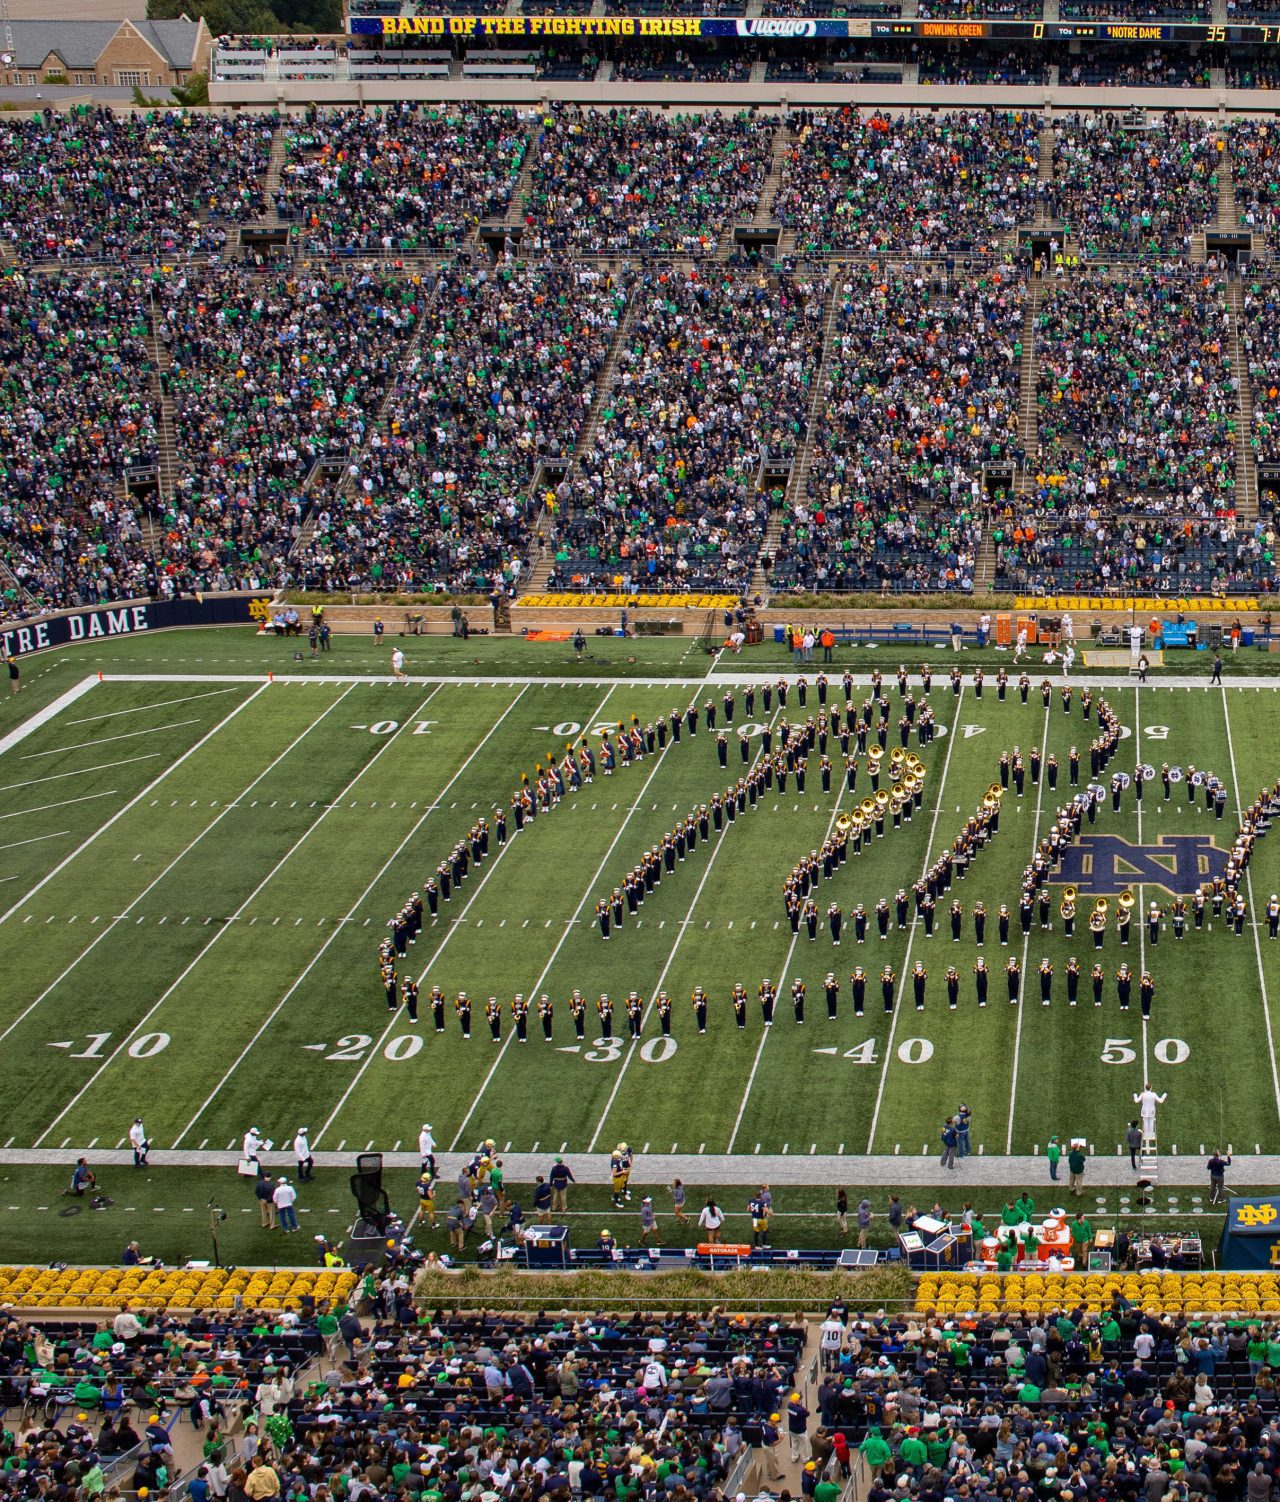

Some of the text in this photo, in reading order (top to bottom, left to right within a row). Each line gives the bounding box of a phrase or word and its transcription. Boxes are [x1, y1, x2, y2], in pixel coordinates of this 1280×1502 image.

[382, 17, 702, 36] BAND OF THE FIGHTING IRISH
[923, 24, 983, 36] BOWLING GREEN
[1033, 24, 1043, 39] 0
[1112, 27, 1137, 39] NOTRE
[1138, 27, 1161, 39] DAME
[1207, 27, 1225, 41] 35
[67, 605, 149, 641] DAME
[69, 1031, 171, 1058] 10
[324, 1034, 425, 1060] 20
[584, 1036, 678, 1062] 30
[843, 1037, 935, 1064] 40
[1100, 1038, 1190, 1064] 50
[750, 1202, 759, 1213] 54
[827, 1330, 838, 1341] 10
